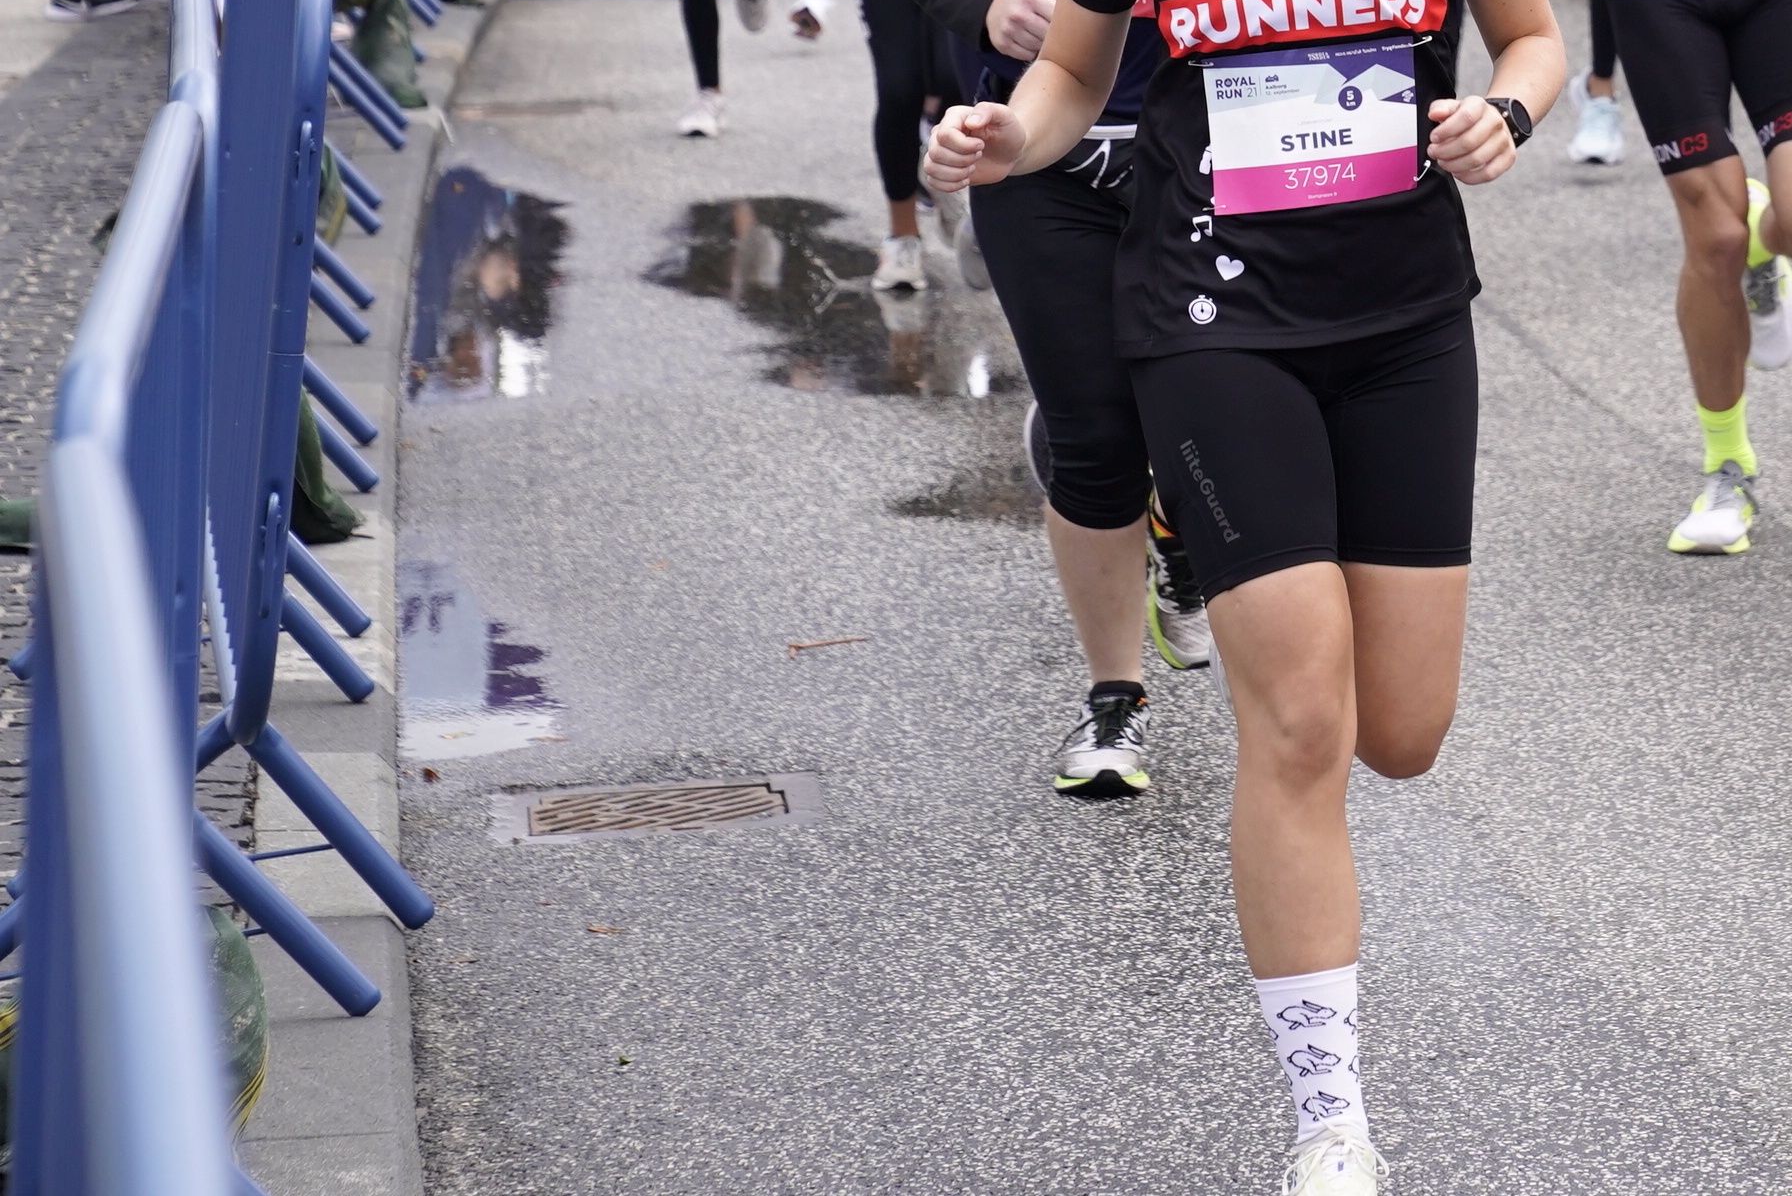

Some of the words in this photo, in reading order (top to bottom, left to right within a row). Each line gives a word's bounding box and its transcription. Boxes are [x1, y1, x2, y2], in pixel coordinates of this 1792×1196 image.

[1215, 76, 1256, 89] ROYAL
[1216, 88, 1243, 100] RUN
[1346, 90, 1355, 101] 5
[1280, 128, 1353, 152] STINE
[1284, 162, 1356, 190] 37974
